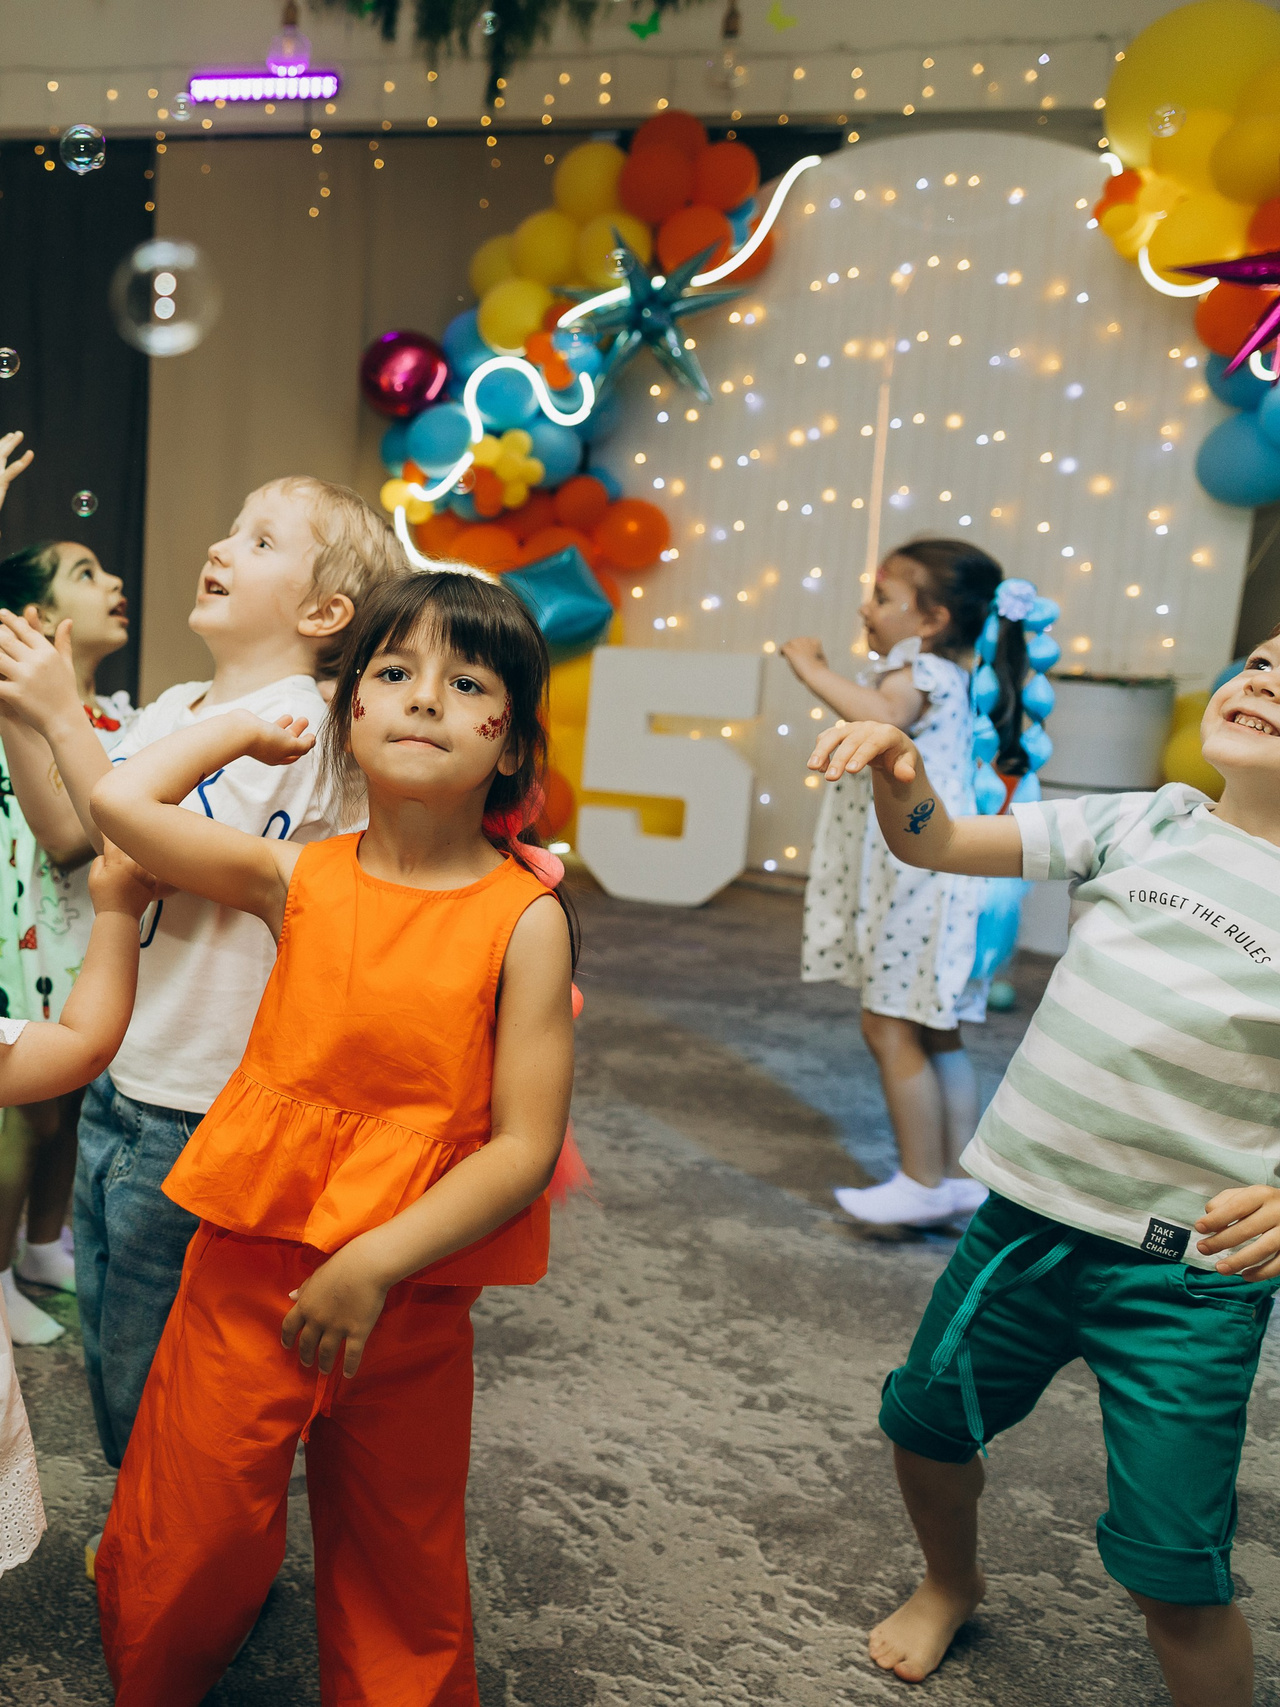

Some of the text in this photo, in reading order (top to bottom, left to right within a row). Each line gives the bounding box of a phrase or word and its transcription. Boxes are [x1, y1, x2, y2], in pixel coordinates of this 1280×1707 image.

[576, 645, 763, 908] 5
[1128, 889, 1272, 964] FORGET THE RULES
[1154, 1224, 1175, 1238] TAKE
[1151, 1233, 1167, 1245] THE
[1146, 1242, 1179, 1257] CHANCE
